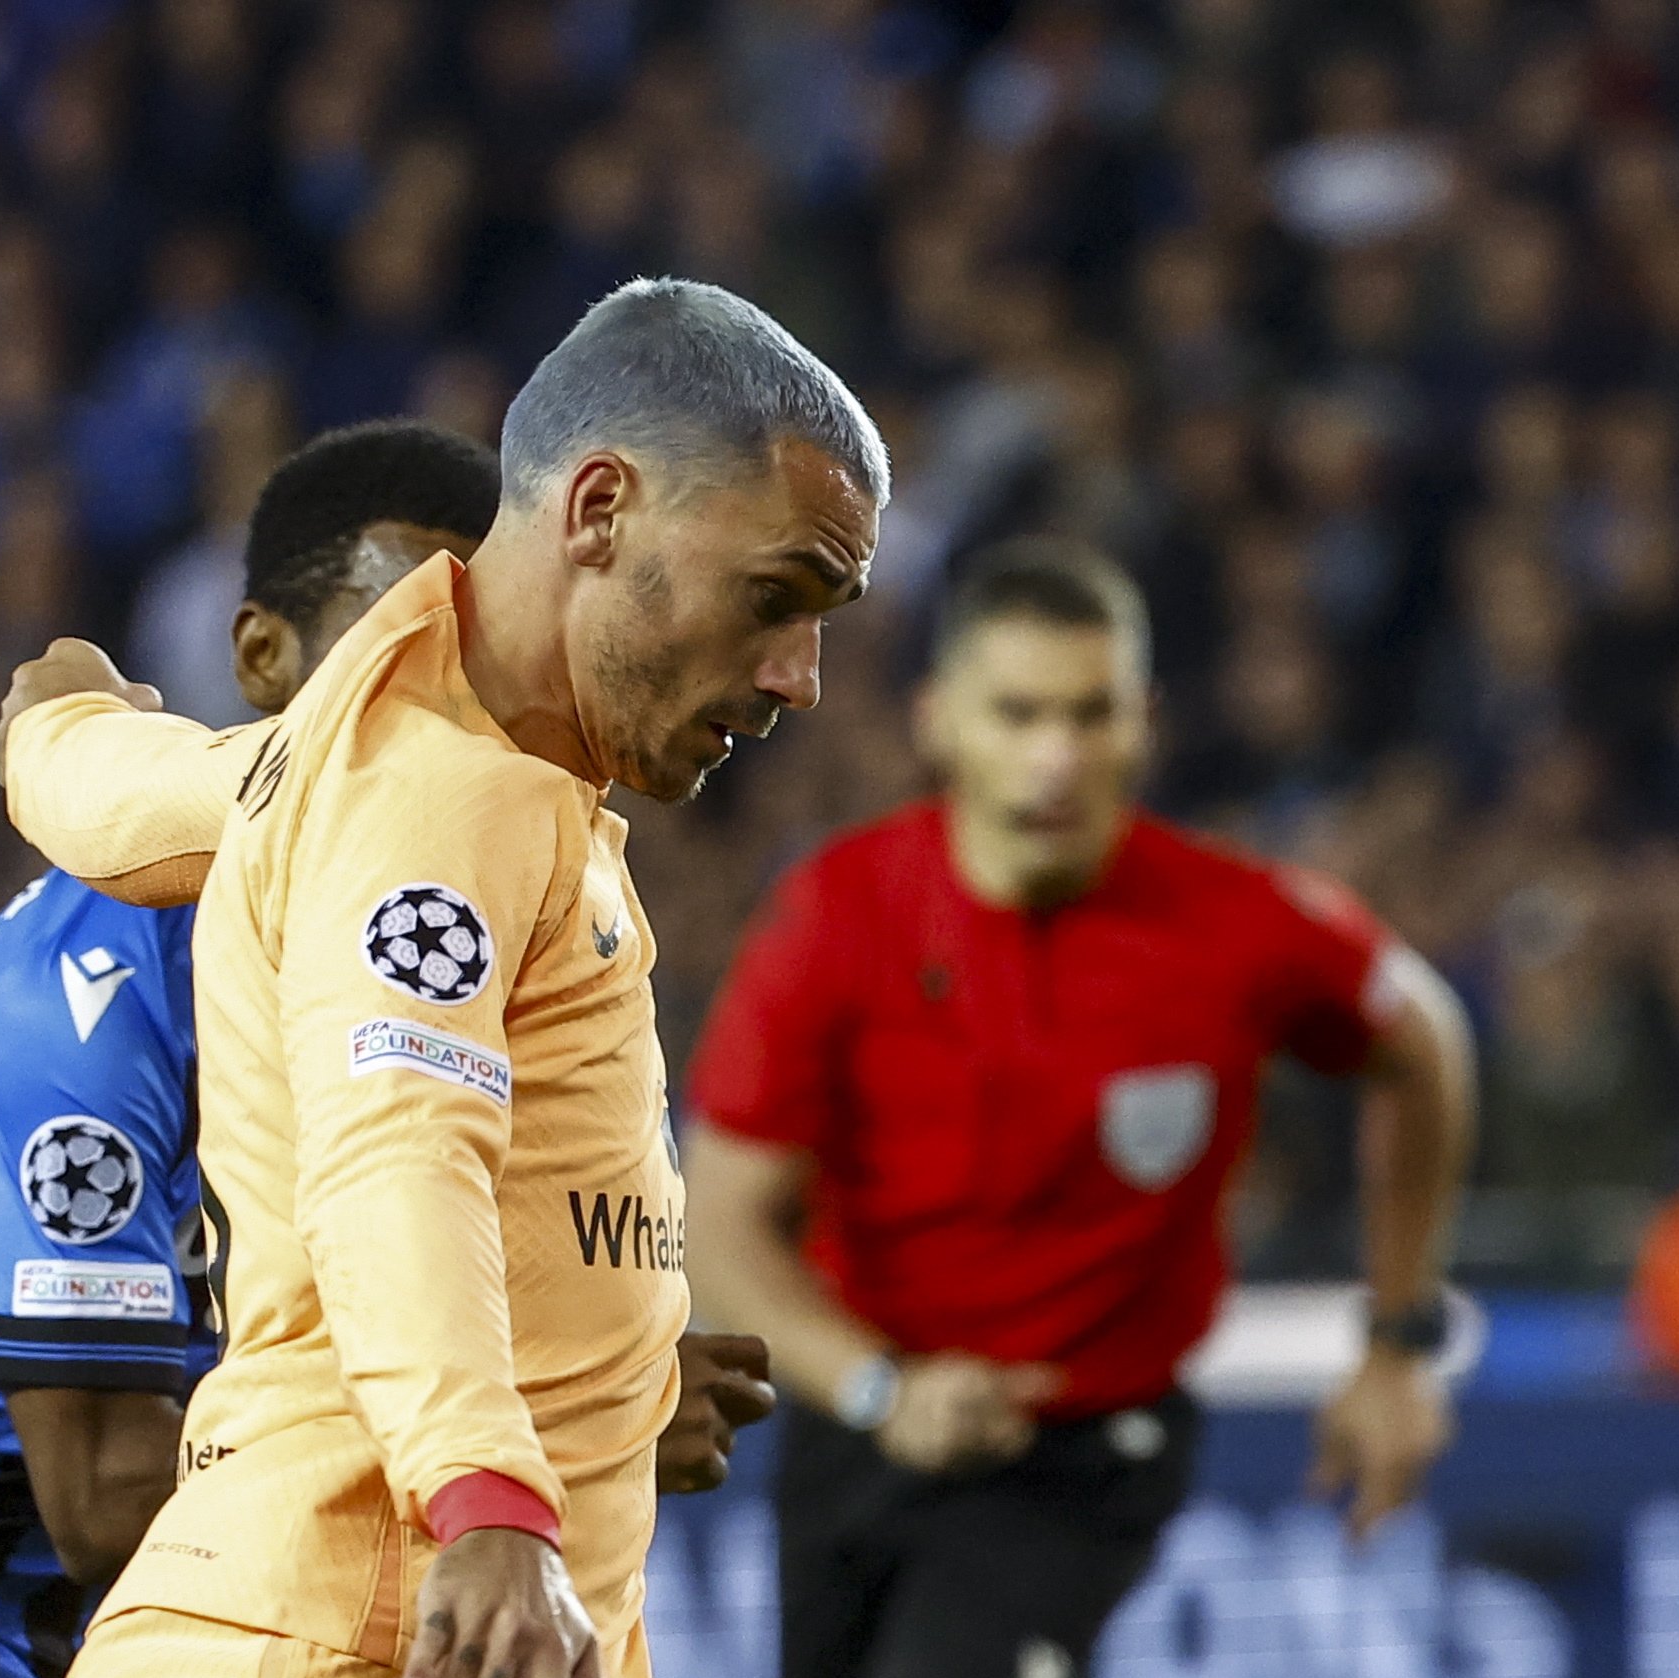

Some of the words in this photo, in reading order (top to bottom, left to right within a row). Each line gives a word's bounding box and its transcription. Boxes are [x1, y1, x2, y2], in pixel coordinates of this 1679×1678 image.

[353, 1021, 389, 1040] UEFA
[354, 1033, 509, 1088] FOUNDATION
[20, 1278, 168, 1299] FOUNDATION
